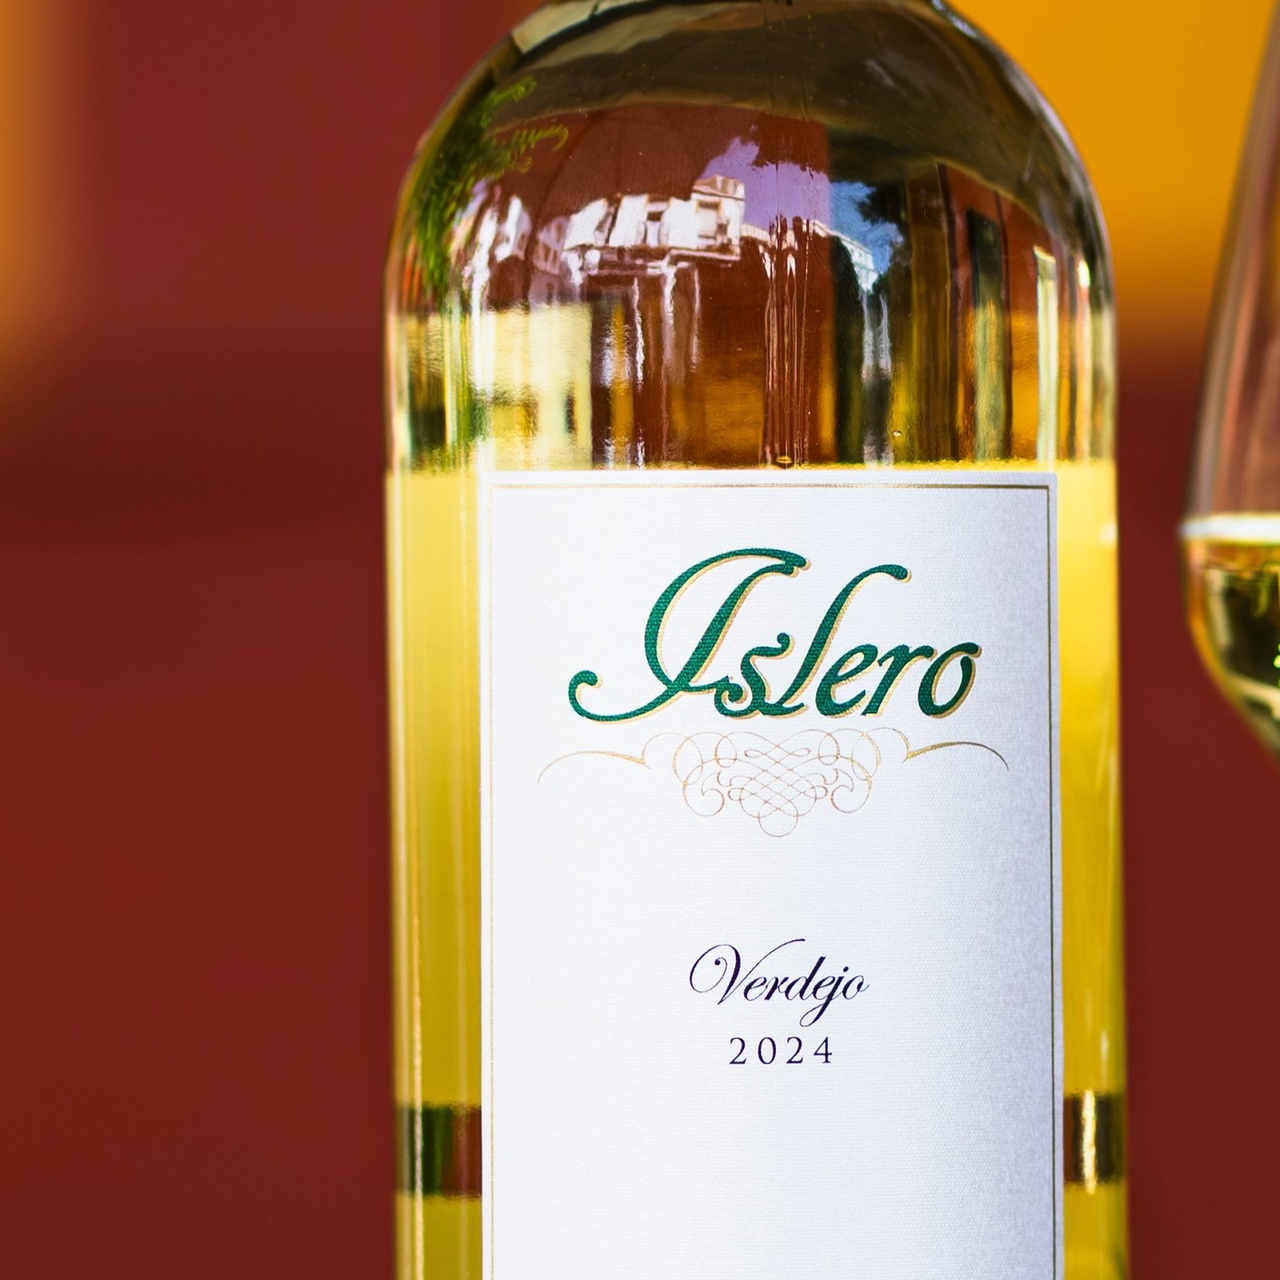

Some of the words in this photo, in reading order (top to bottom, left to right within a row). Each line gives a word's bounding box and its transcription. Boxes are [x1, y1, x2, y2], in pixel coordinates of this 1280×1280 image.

[568, 547, 983, 723] Islero
[689, 937, 870, 1028] Verdejo
[729, 1036, 833, 1065] 2024
